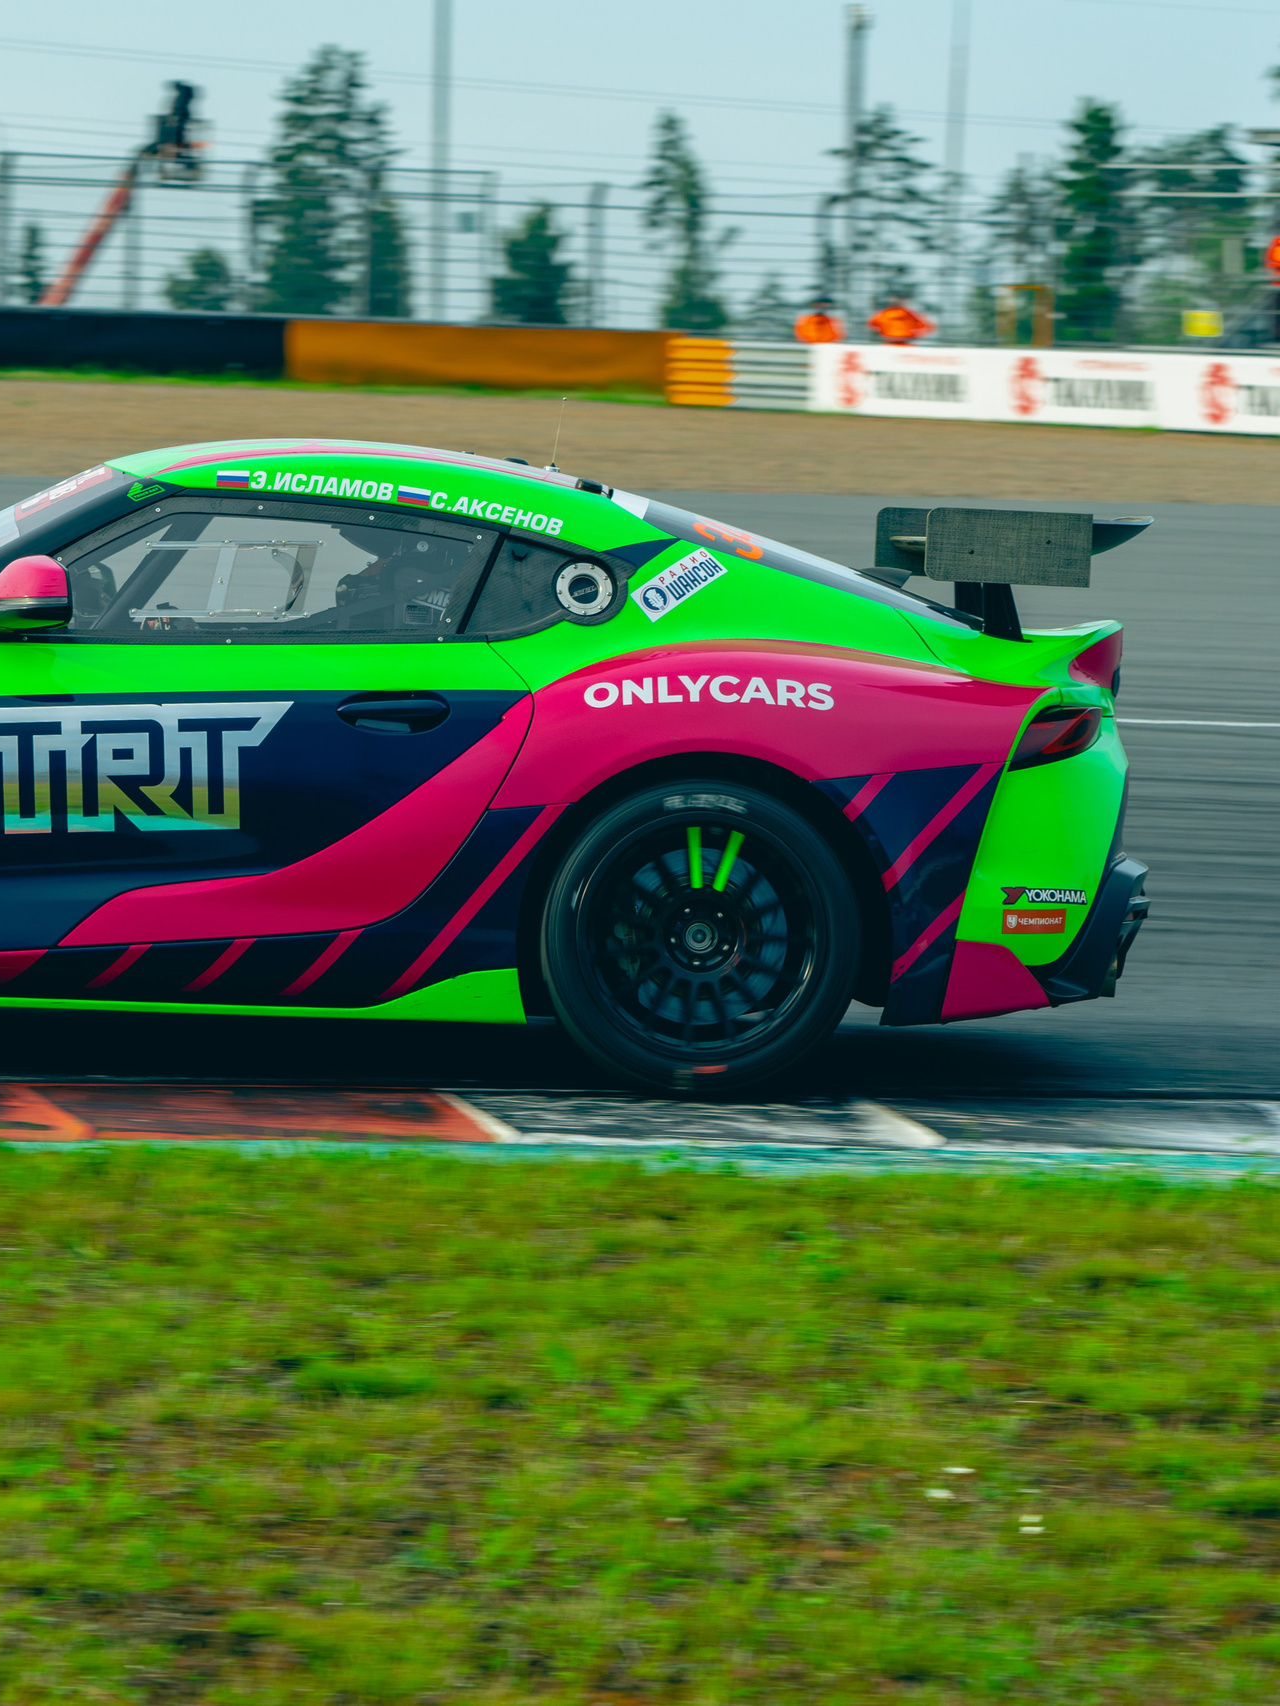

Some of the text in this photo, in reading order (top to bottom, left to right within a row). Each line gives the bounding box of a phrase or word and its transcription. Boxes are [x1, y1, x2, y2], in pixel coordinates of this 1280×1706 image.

[250, 471, 394, 501] Э.ИСЛАМОВ
[430, 491, 564, 536] С.АКСЕНОВ
[658, 550, 708, 585] РАДИО
[665, 557, 723, 601] ШАНСОН
[583, 675, 835, 711] ONLYCARS
[1025, 889, 1087, 904] YOKOHAMA
[1018, 917, 1063, 925] ЧЕМПИОНАТ
